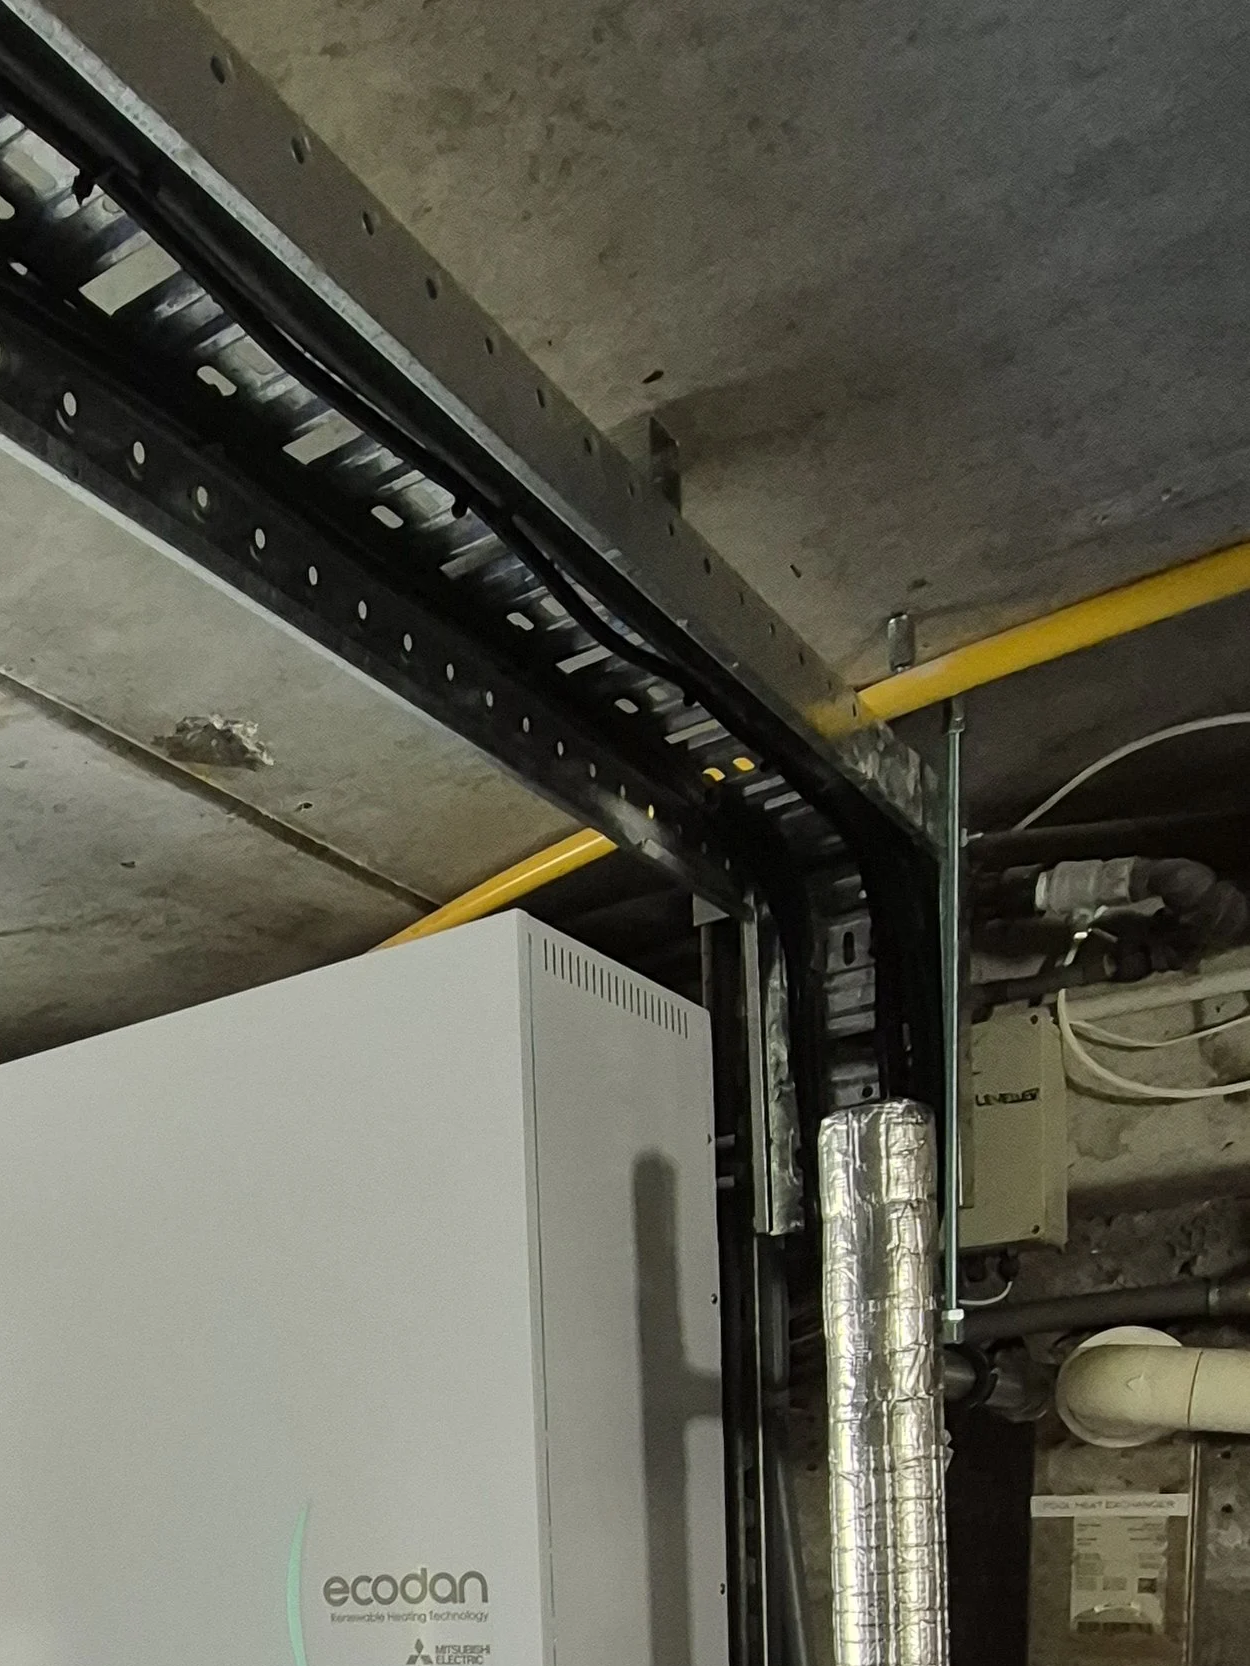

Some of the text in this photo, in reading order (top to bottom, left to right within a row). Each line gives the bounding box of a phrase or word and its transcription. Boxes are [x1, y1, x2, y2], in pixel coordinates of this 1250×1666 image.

[322, 1567, 489, 1607] ecodan
[388, 1611, 427, 1623] Heating
[429, 1609, 489, 1623] Technology
[434, 1644, 491, 1655] MITSUBISHI
[435, 1655, 484, 1665] ELECTRIC
